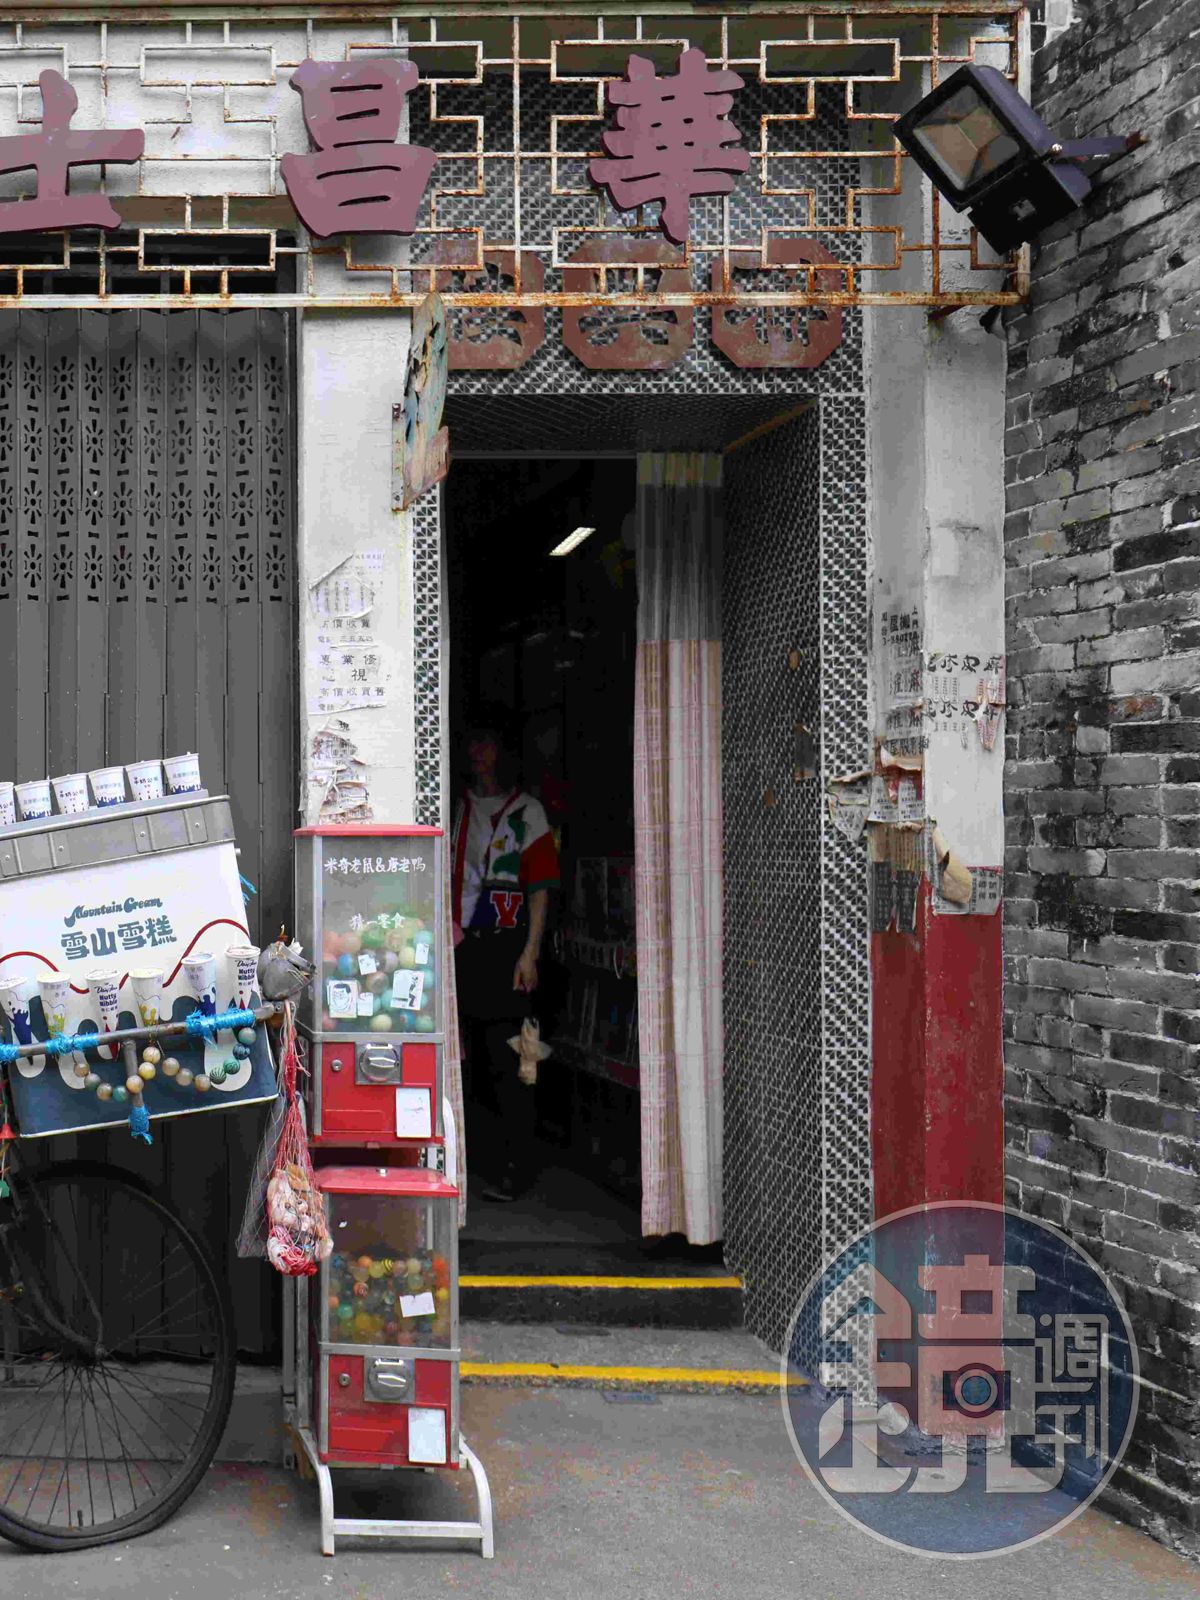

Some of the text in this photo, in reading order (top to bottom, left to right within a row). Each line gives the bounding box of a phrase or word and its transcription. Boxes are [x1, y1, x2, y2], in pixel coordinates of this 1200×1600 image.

[63, 896, 163, 928] Mountain Cream
[60, 914, 178, 961] 雪山雪糕
